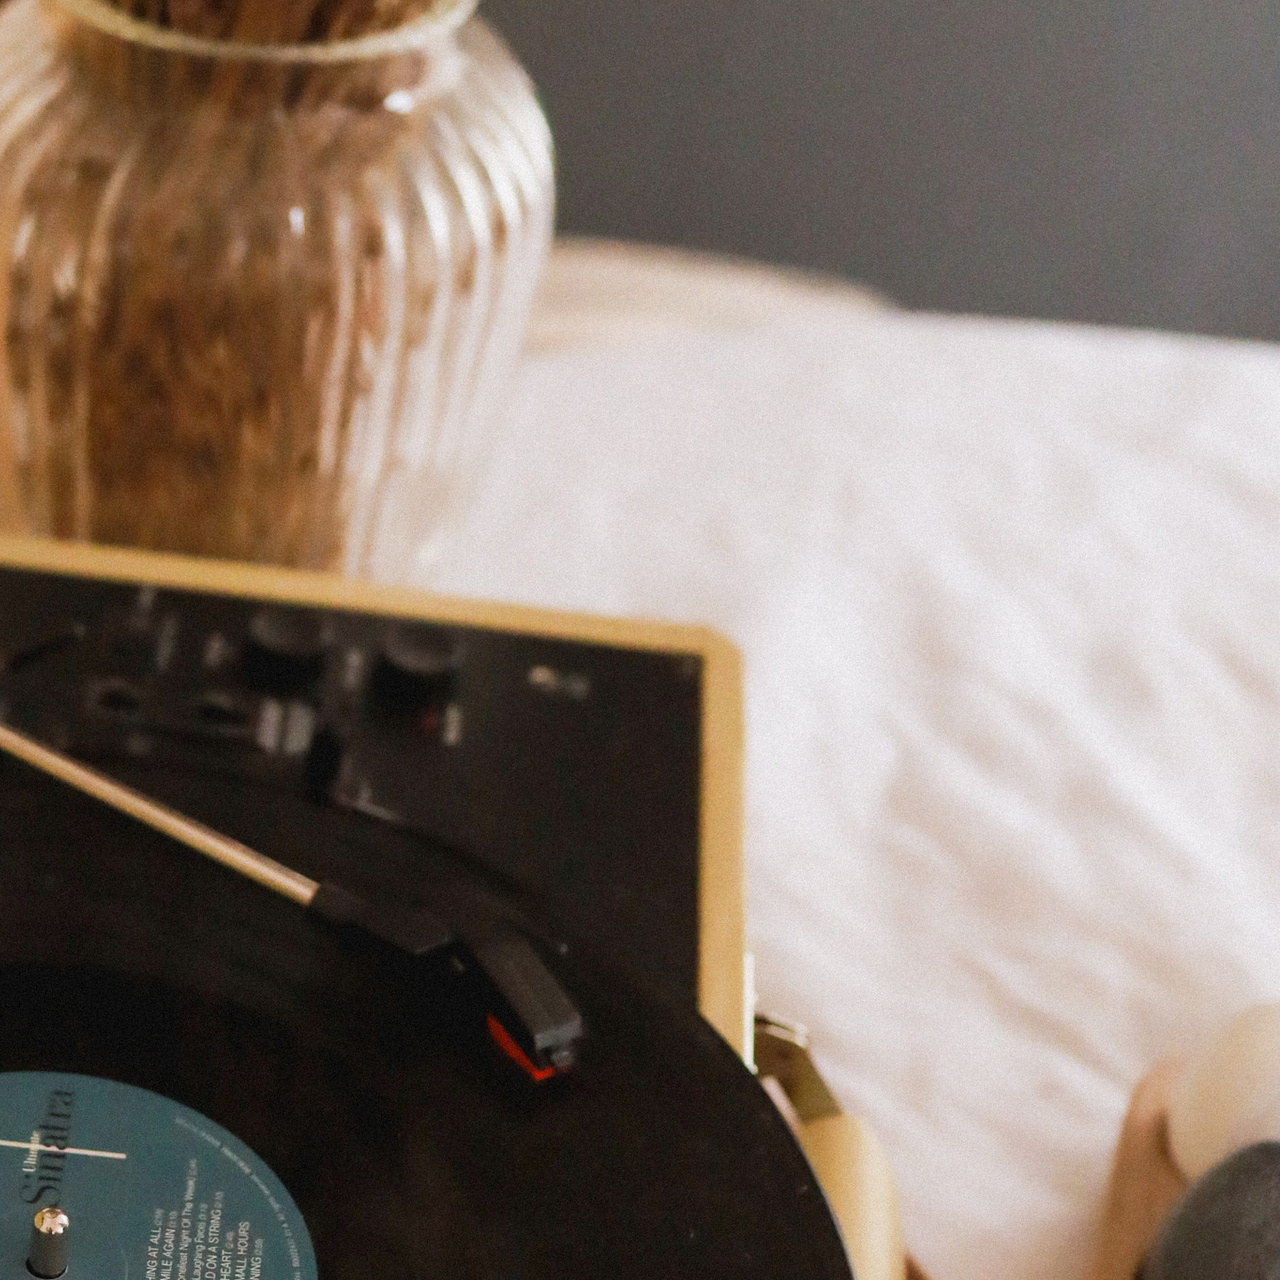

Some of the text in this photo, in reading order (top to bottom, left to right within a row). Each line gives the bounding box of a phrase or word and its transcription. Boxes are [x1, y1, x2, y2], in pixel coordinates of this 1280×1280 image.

[21, 1090, 73, 1207] Sinatra
[182, 1202, 193, 1216] The
[150, 1228, 161, 1244] ALL
[178, 1230, 192, 1250] Night
[208, 1210, 221, 1244] STRING
[237, 1222, 250, 1255] HOURS
[148, 1246, 158, 1258] AT
[162, 1228, 176, 1258] AGAIN
[192, 1245, 205, 1280] Laughing
[206, 1256, 217, 1269] ON
[220, 1250, 232, 1280] HEART
